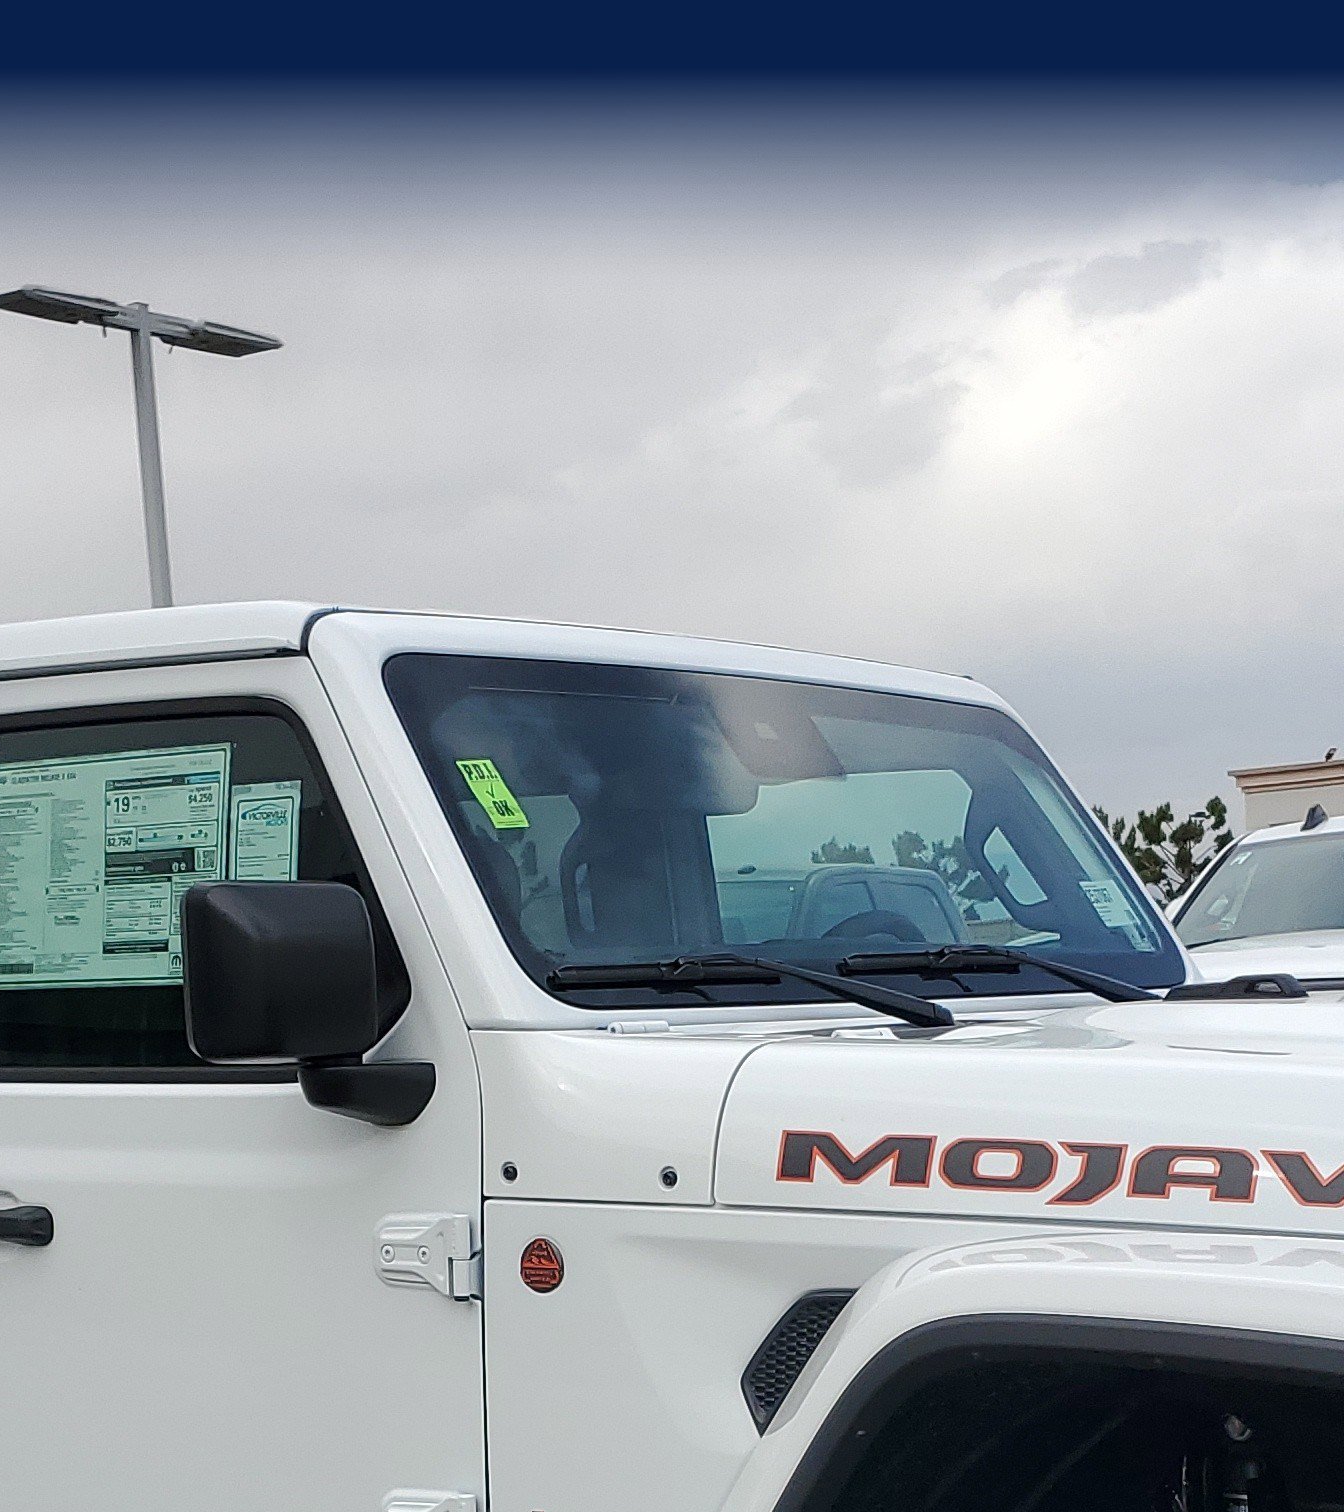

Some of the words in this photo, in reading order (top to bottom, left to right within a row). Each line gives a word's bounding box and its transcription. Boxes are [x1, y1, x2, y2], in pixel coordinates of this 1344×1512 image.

[460, 763, 498, 780] P.D.I.
[113, 796, 130, 813] 19
[491, 800, 515, 816] OK
